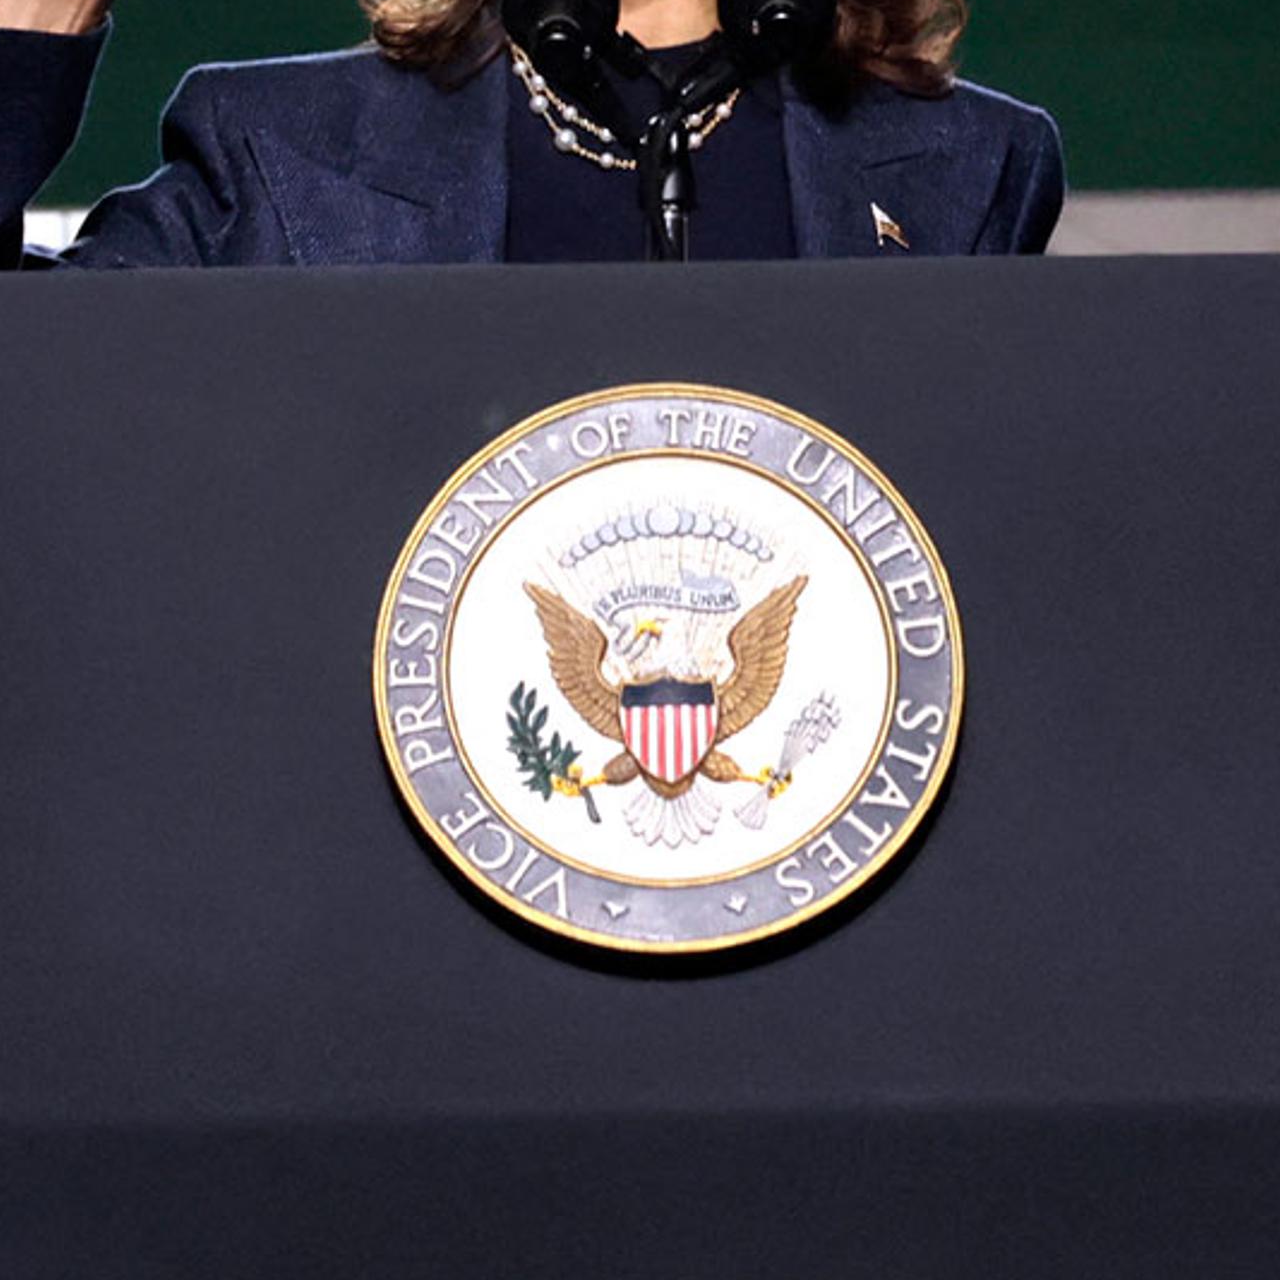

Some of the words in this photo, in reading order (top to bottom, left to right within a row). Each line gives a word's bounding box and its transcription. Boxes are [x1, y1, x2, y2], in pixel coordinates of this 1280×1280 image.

[570, 411, 633, 458] OF
[660, 407, 756, 456] THE
[390, 442, 539, 770] PRESIDENT
[786, 435, 947, 659] UNITED
[443, 794, 570, 918] VICE
[775, 700, 945, 908] STATES
